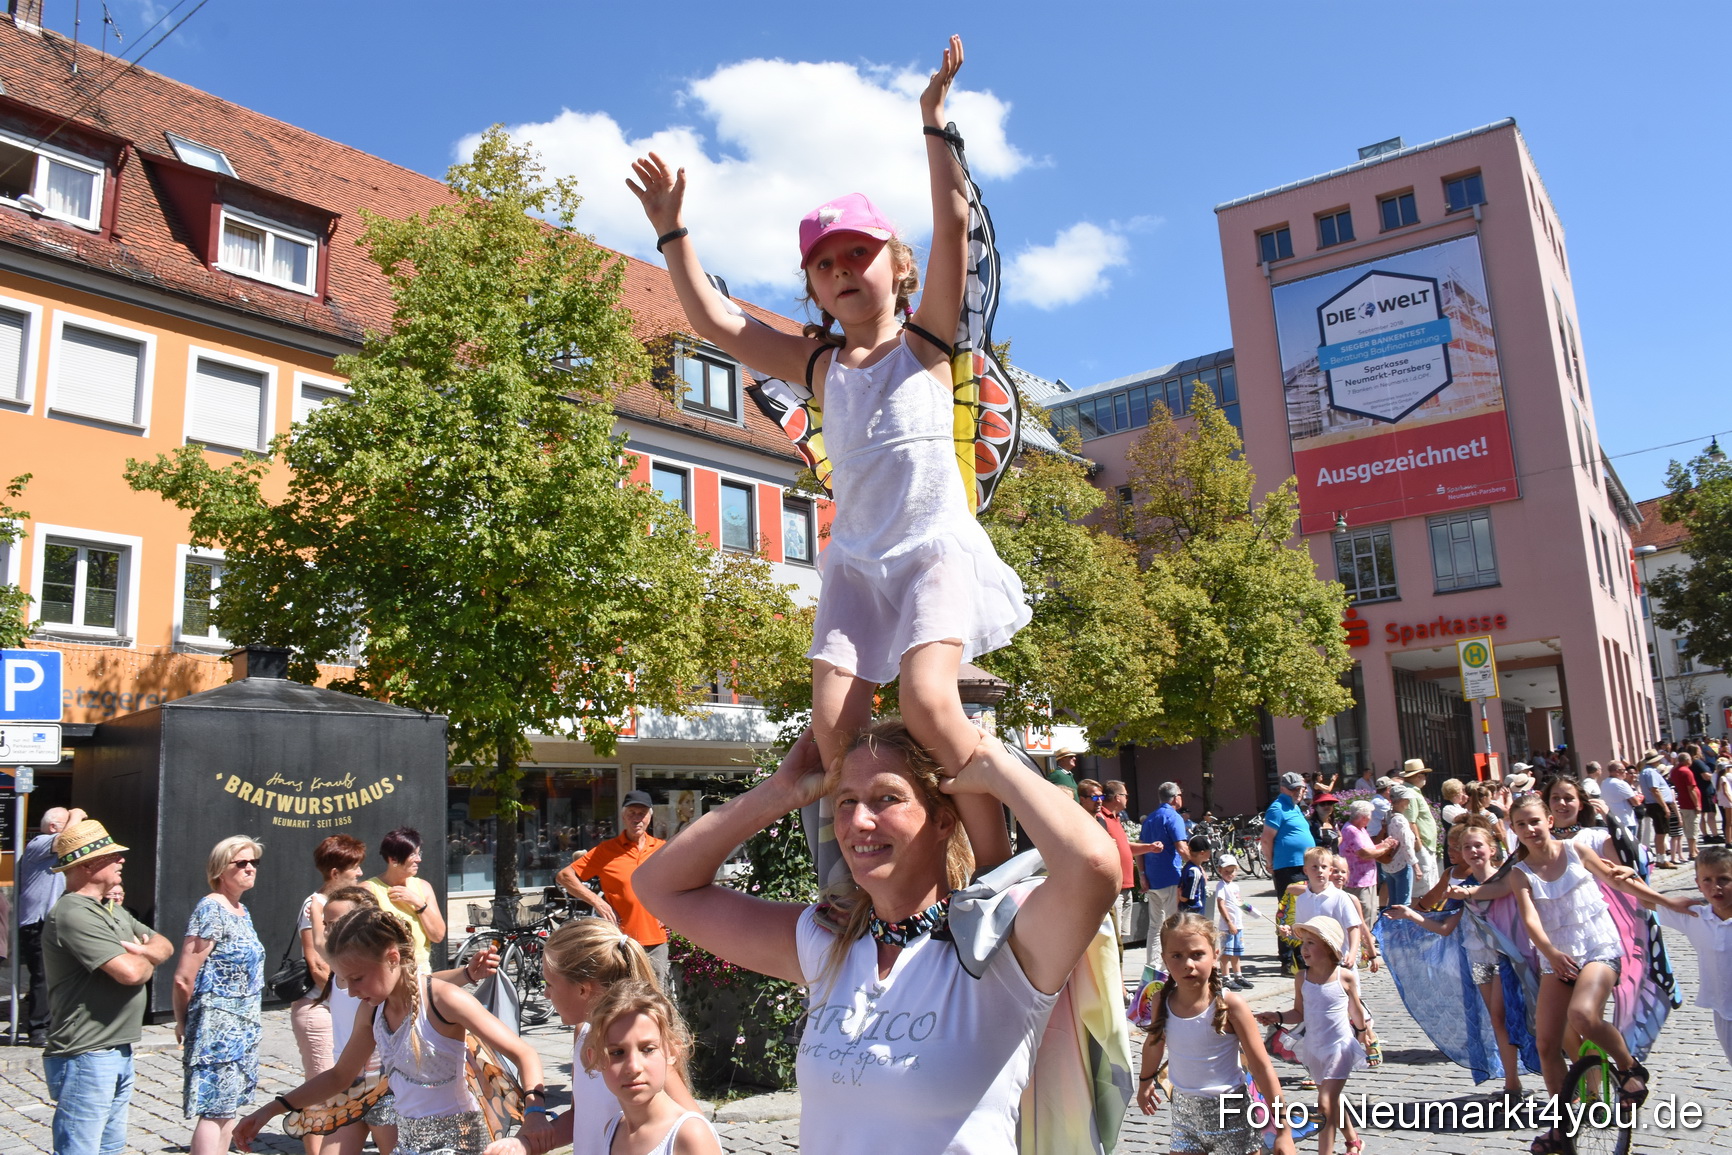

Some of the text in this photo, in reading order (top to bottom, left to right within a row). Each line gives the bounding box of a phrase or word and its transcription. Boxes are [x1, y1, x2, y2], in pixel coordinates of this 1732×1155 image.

[1326, 307, 1356, 326] DIE
[1340, 327, 1426, 353] SIEGER BANKENTEST
[1358, 324, 1389, 335] September
[1330, 334, 1440, 365] Beratung Baufinanzierung
[1344, 363, 1431, 387] Neumarkt-Parsberg
[1364, 358, 1409, 374] Sparkasse
[1352, 386, 1373, 395] Banken
[1316, 436, 1489, 487] Ausgezeichnet!
[1447, 486, 1507, 500] Neumarkt-Parsberg
[1385, 613, 1507, 646] Sparkasse
[1469, 648, 1482, 662] H
[5, 659, 45, 712] P
[62, 686, 168, 717] etzgerei
[266, 772, 303, 792] Hans
[224, 774, 395, 815] BRATWURSTHAUS
[272, 816, 352, 828] NEUMARKT SEIT 1858
[829, 1045, 857, 1066] of
[855, 1051, 920, 1071] sports
